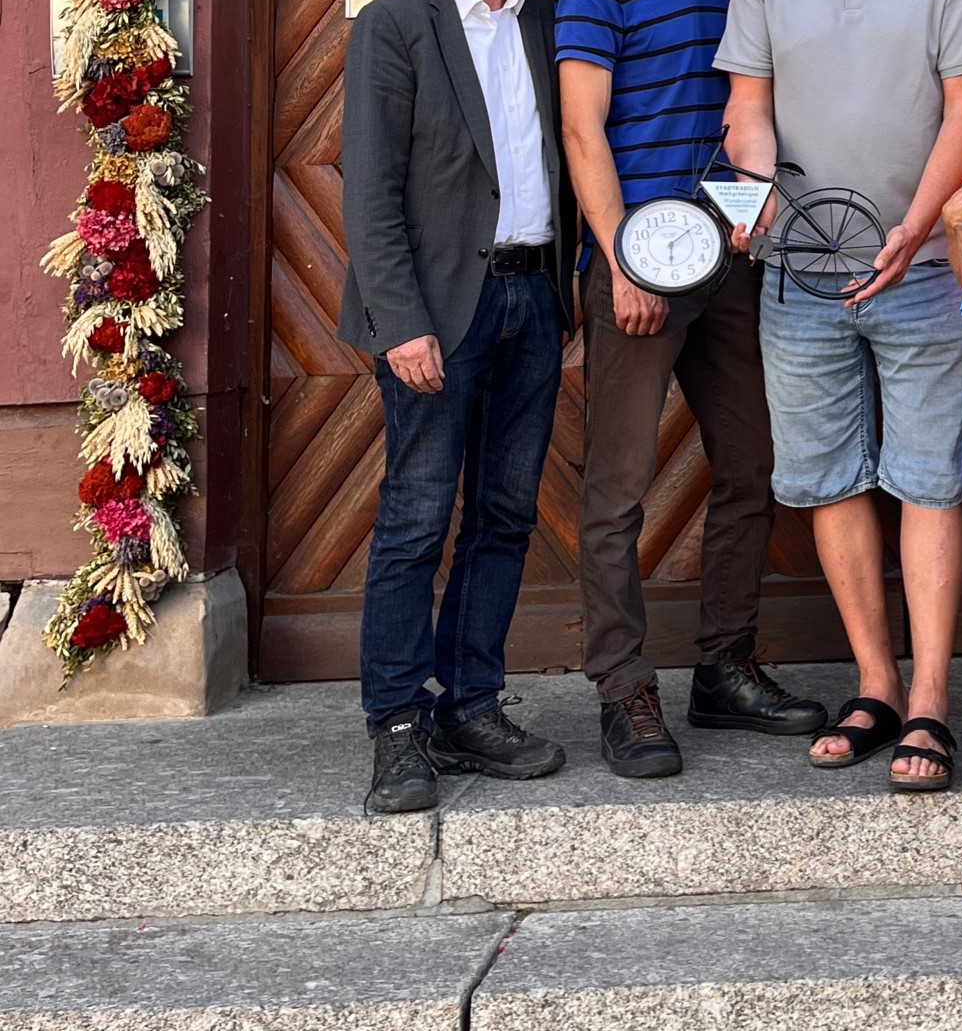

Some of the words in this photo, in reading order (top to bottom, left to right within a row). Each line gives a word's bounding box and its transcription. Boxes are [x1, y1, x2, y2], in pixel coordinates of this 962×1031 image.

[646, 217, 660, 228] 11
[660, 211, 676, 223] 12
[683, 215, 689, 225] 1
[635, 229, 650, 241] 10
[695, 224, 703, 235] 2
[632, 244, 641, 254] 9
[701, 238, 710, 249] 3
[640, 257, 648, 268] 8
[698, 254, 706, 263] 4
[652, 268, 661, 279] 7
[688, 264, 696, 275] 5
[671, 270, 680, 281] 6
